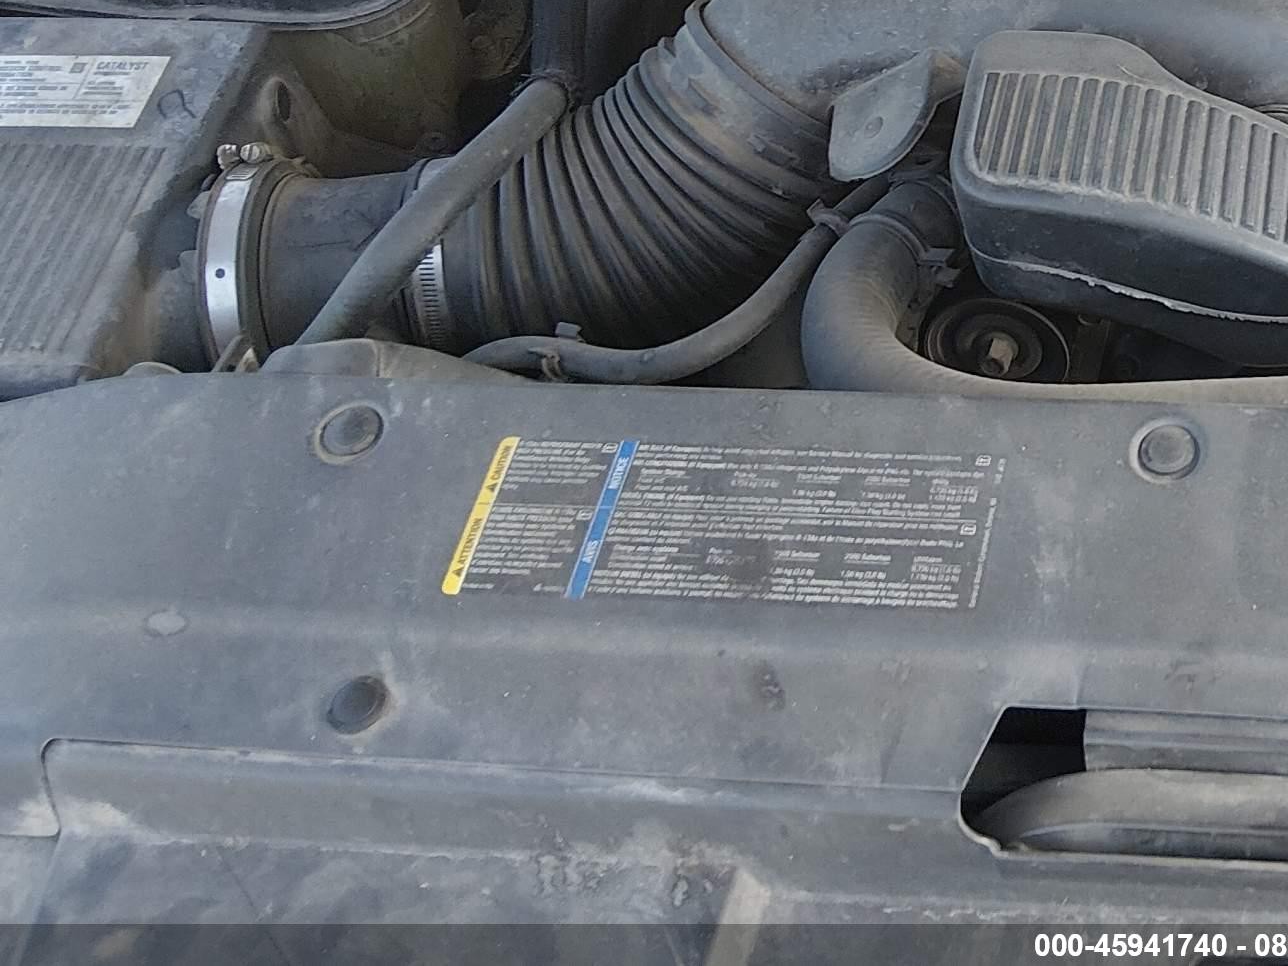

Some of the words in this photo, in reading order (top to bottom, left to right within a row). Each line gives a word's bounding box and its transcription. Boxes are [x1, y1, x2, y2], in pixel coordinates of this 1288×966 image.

[96, 61, 149, 71] CATALYST
[491, 445, 512, 481] CAUTION
[608, 457, 630, 490] NOTICE
[459, 518, 484, 564] ATTENTION
